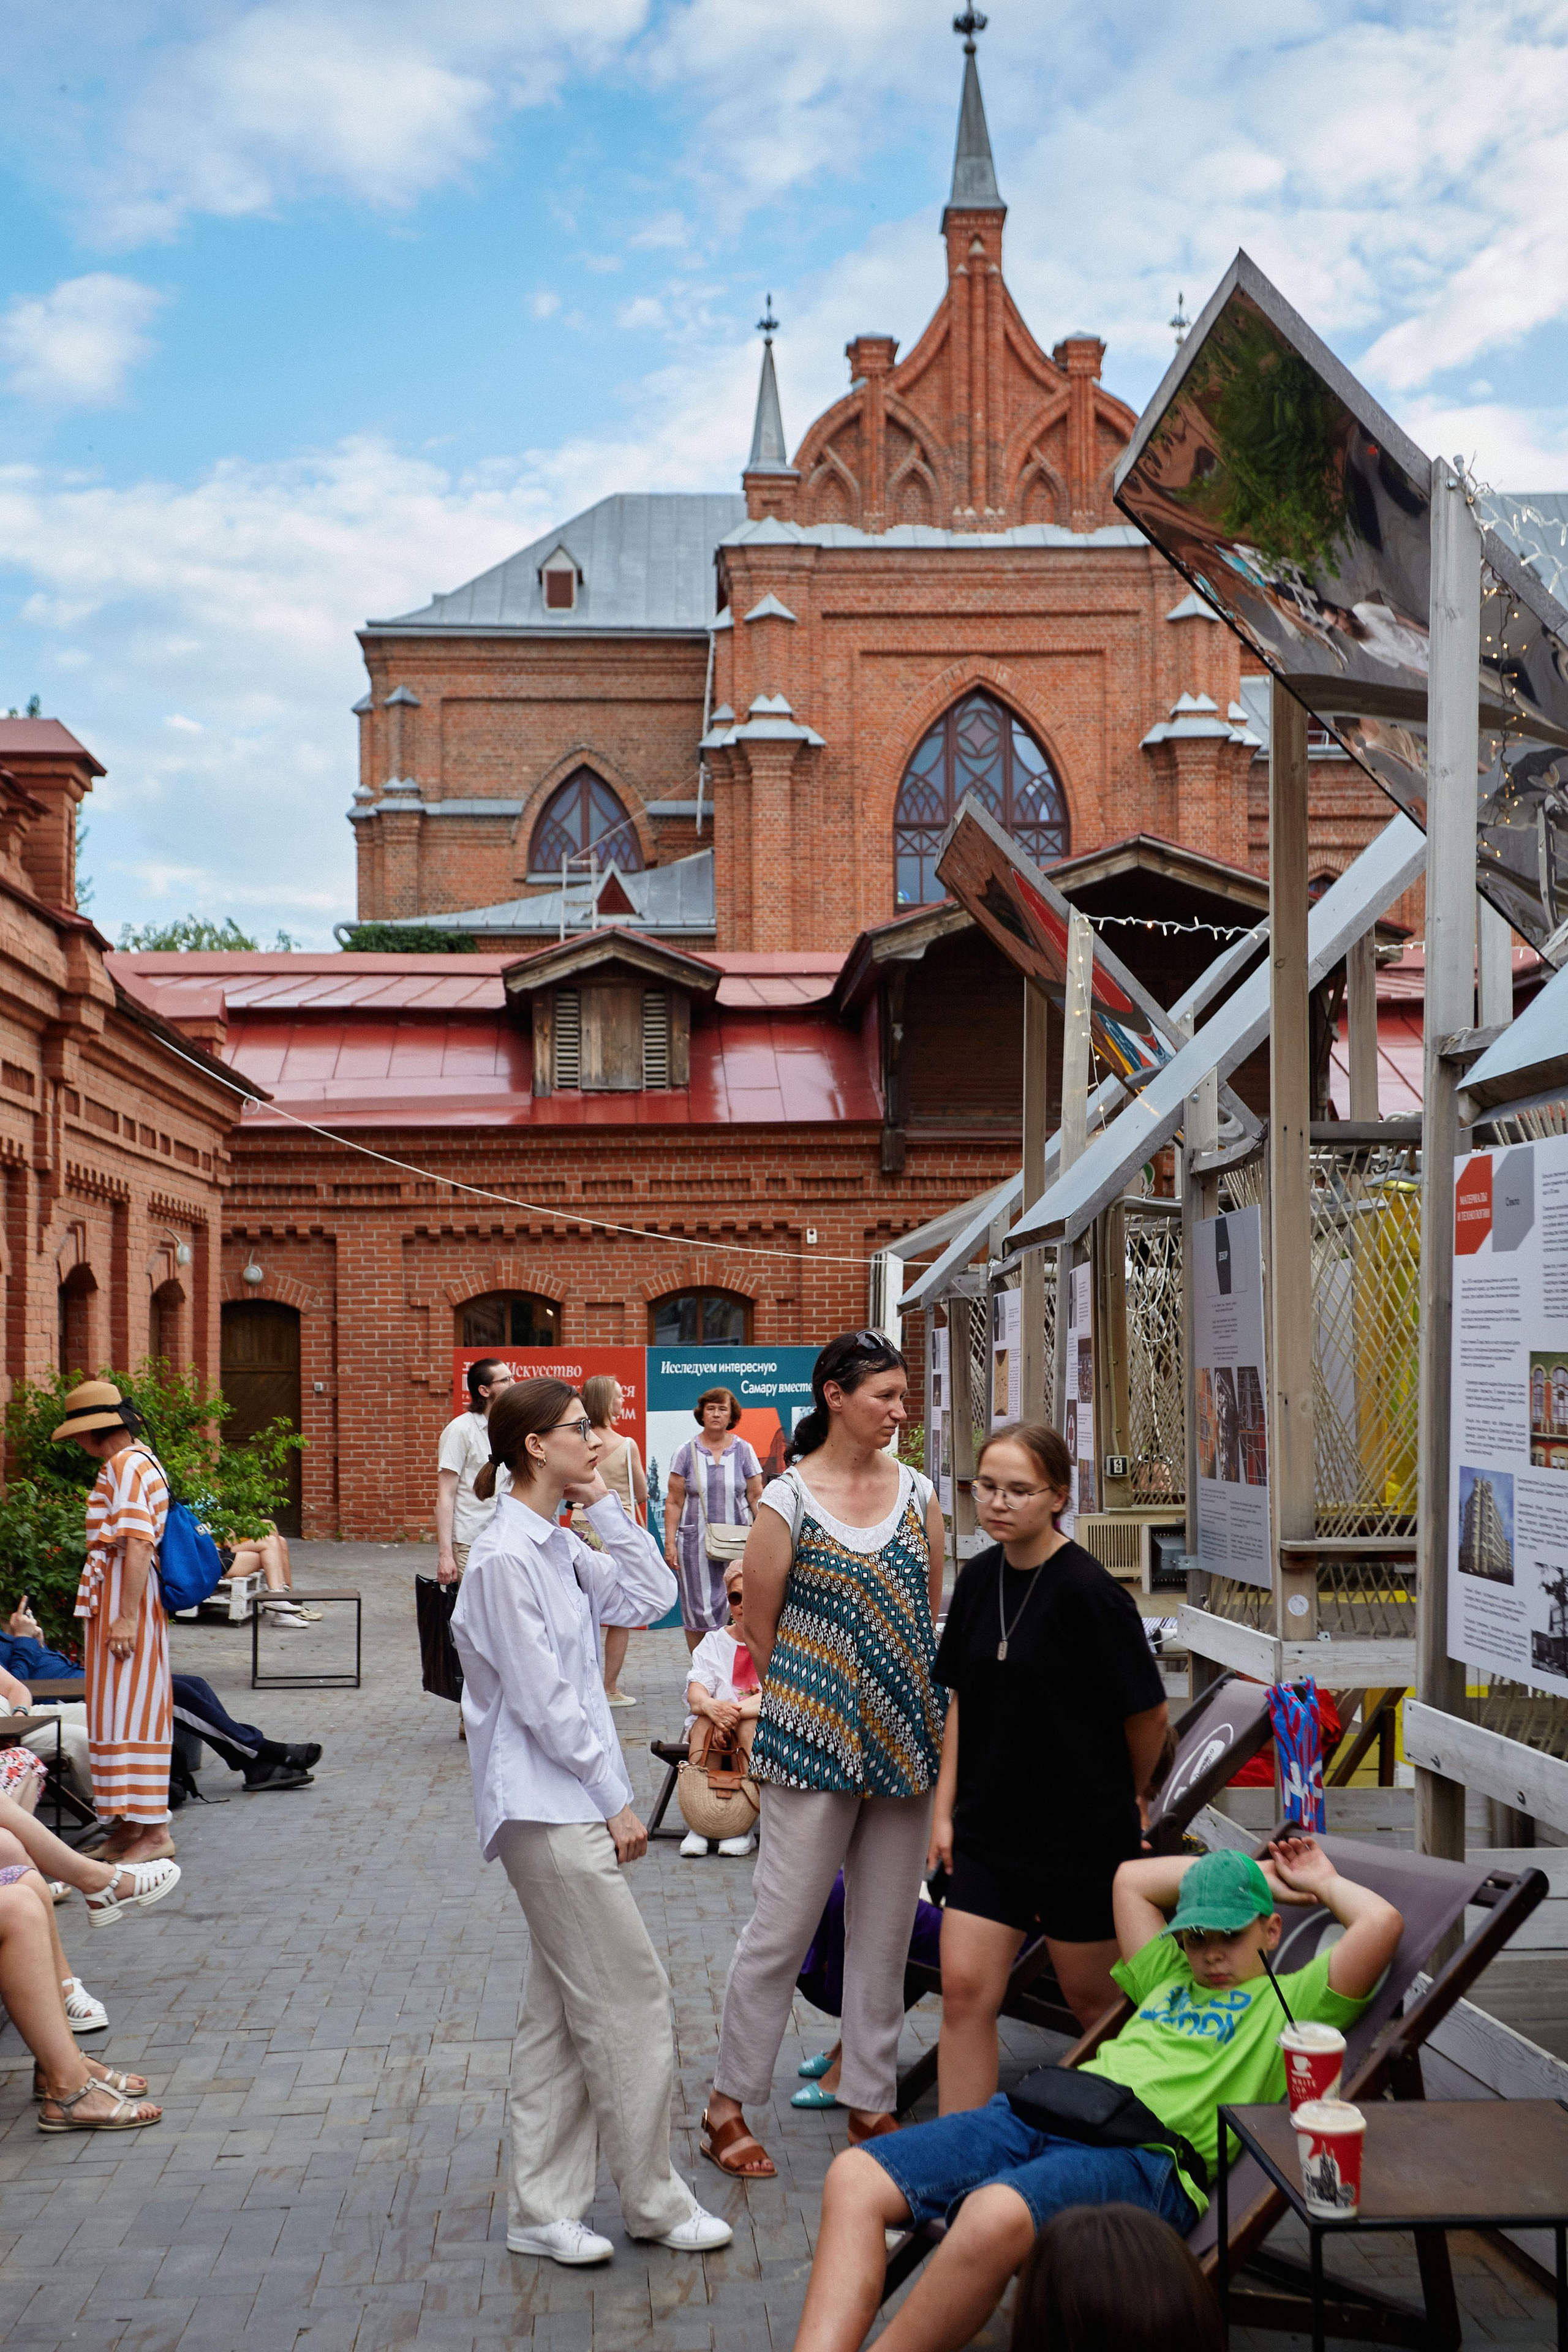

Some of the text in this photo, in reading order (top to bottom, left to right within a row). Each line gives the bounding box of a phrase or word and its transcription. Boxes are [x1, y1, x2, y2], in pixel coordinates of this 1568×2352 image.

[507, 1362, 582, 1378] Искусство
[661, 1361, 777, 1376] Исследуем интересную
[741, 1380, 812, 1396] Самару вместе
